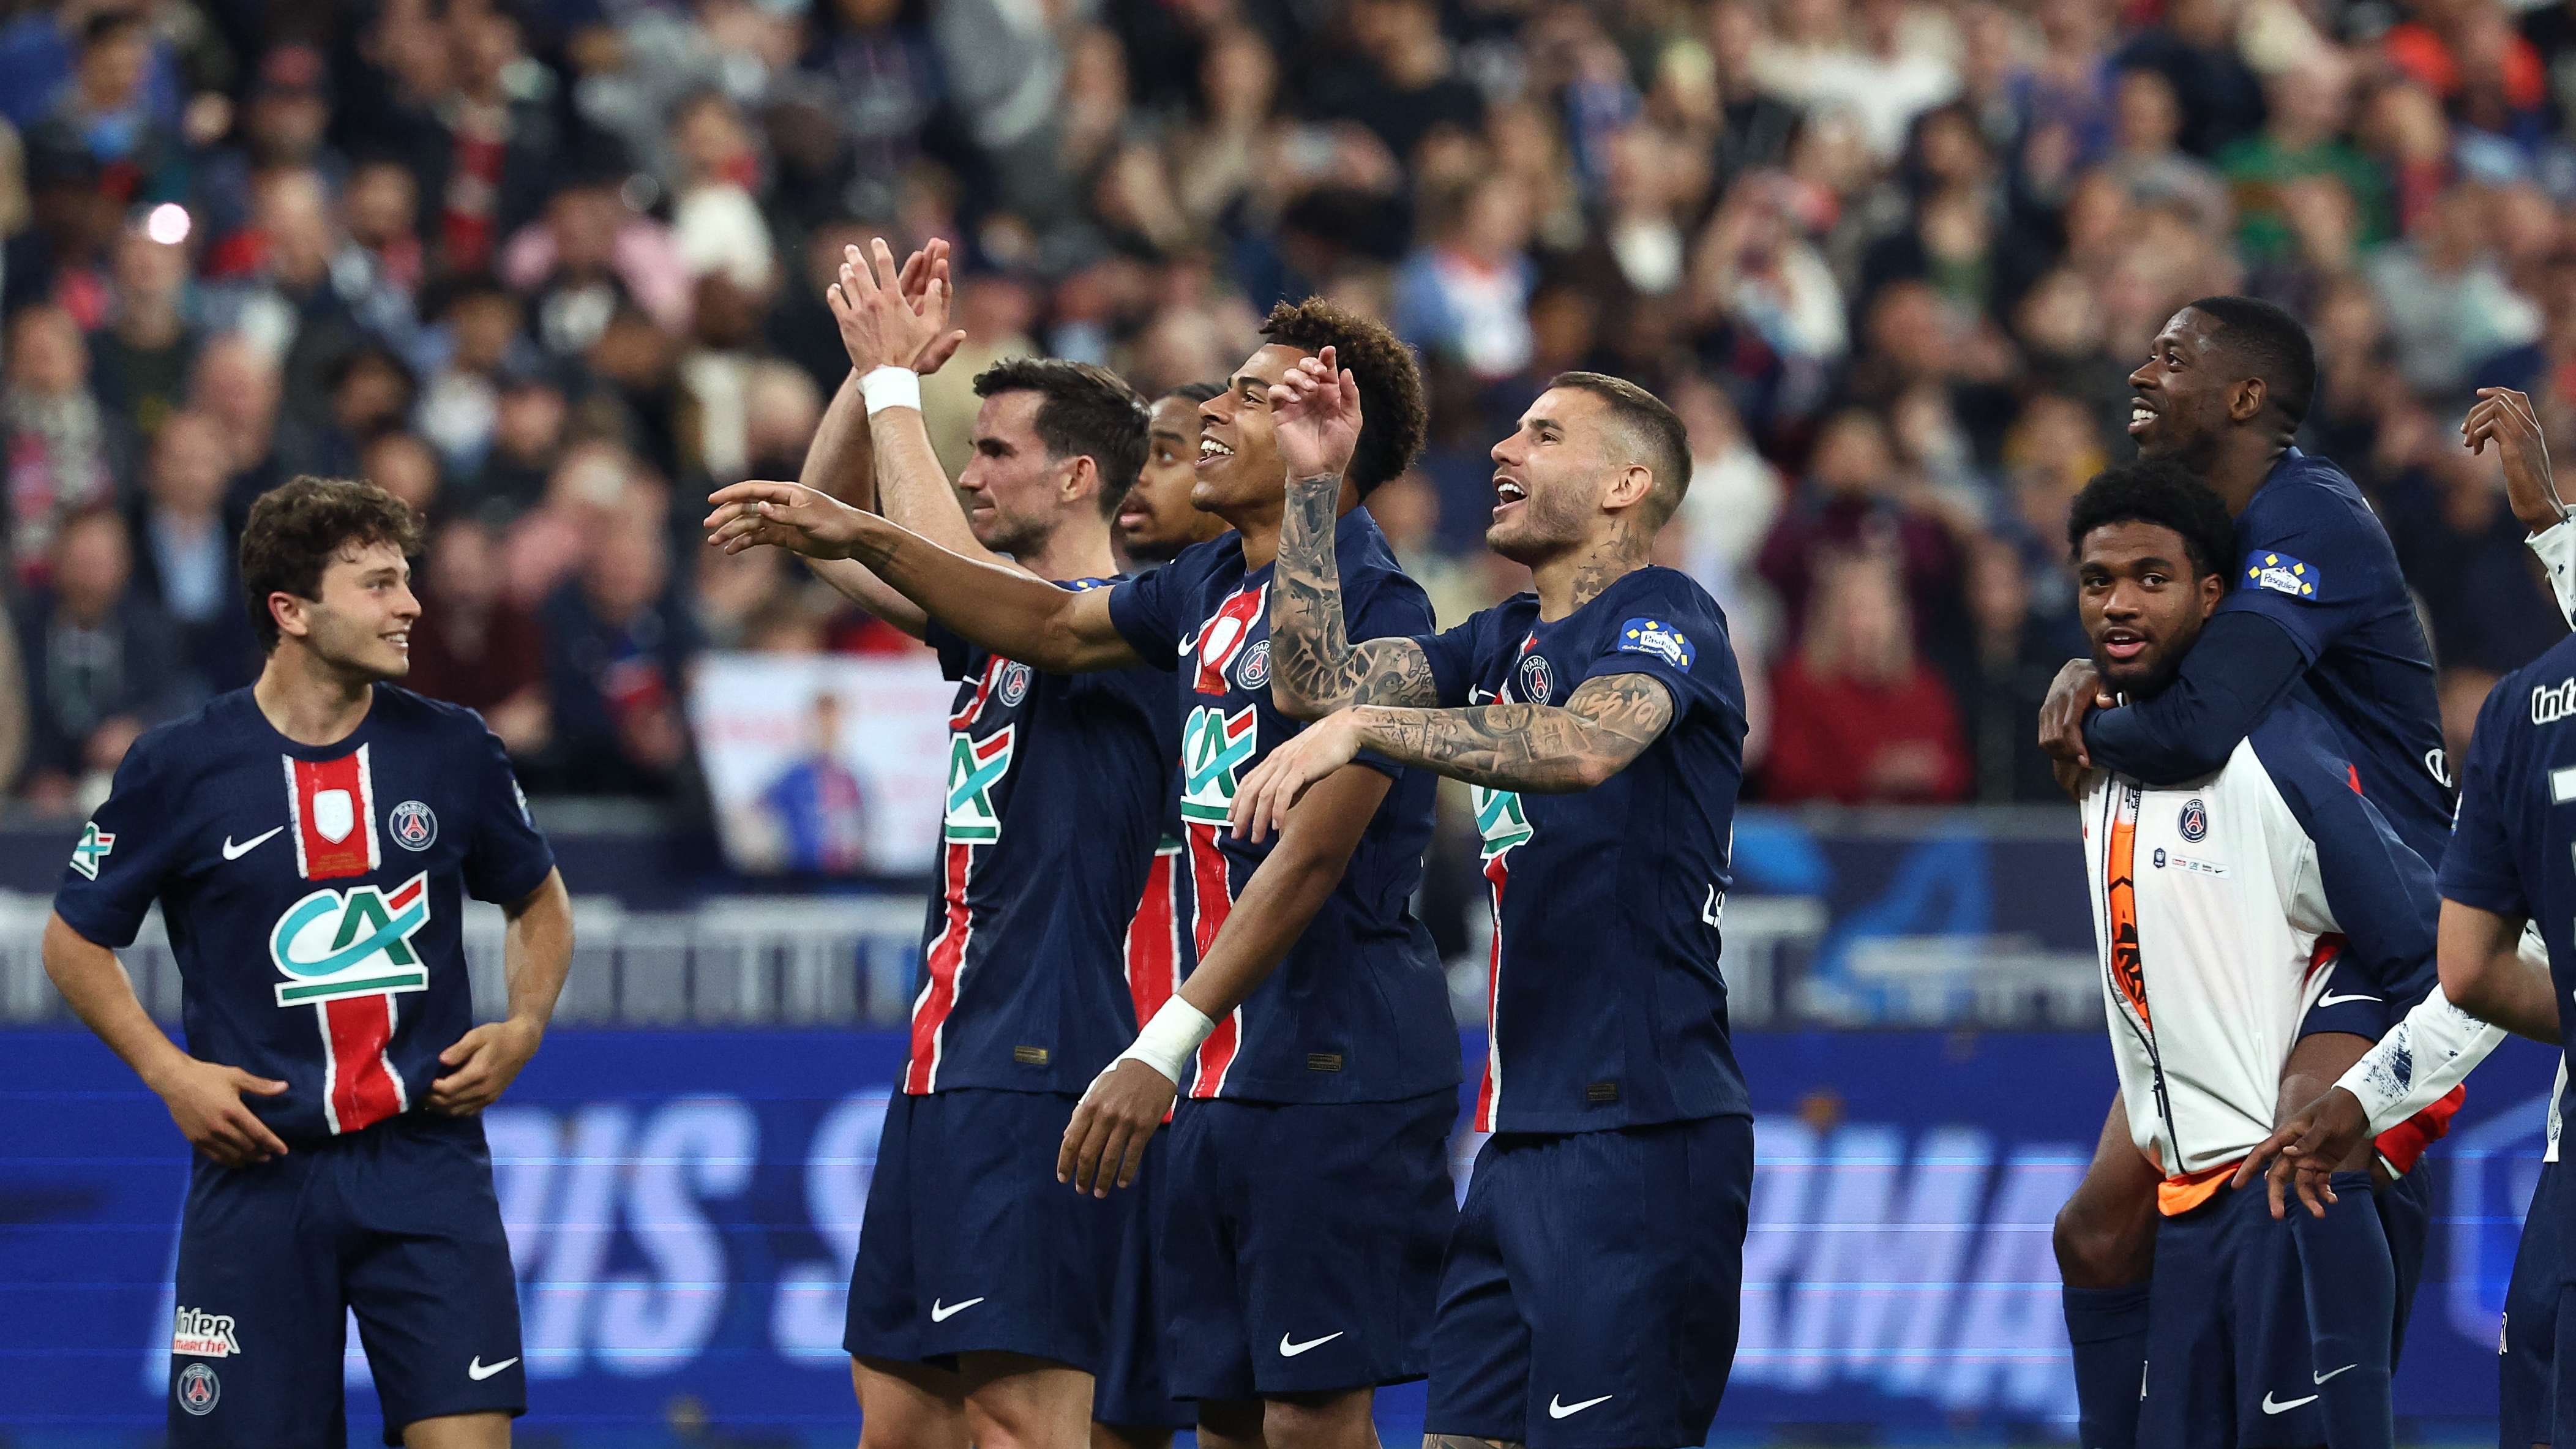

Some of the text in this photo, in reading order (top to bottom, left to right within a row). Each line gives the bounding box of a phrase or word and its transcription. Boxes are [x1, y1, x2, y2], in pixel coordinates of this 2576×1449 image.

[2264, 573, 2296, 591] Pasquier
[1644, 634, 1677, 655] Pasquier
[1524, 657, 1546, 673] PARIS
[2532, 683, 2576, 722] Int
